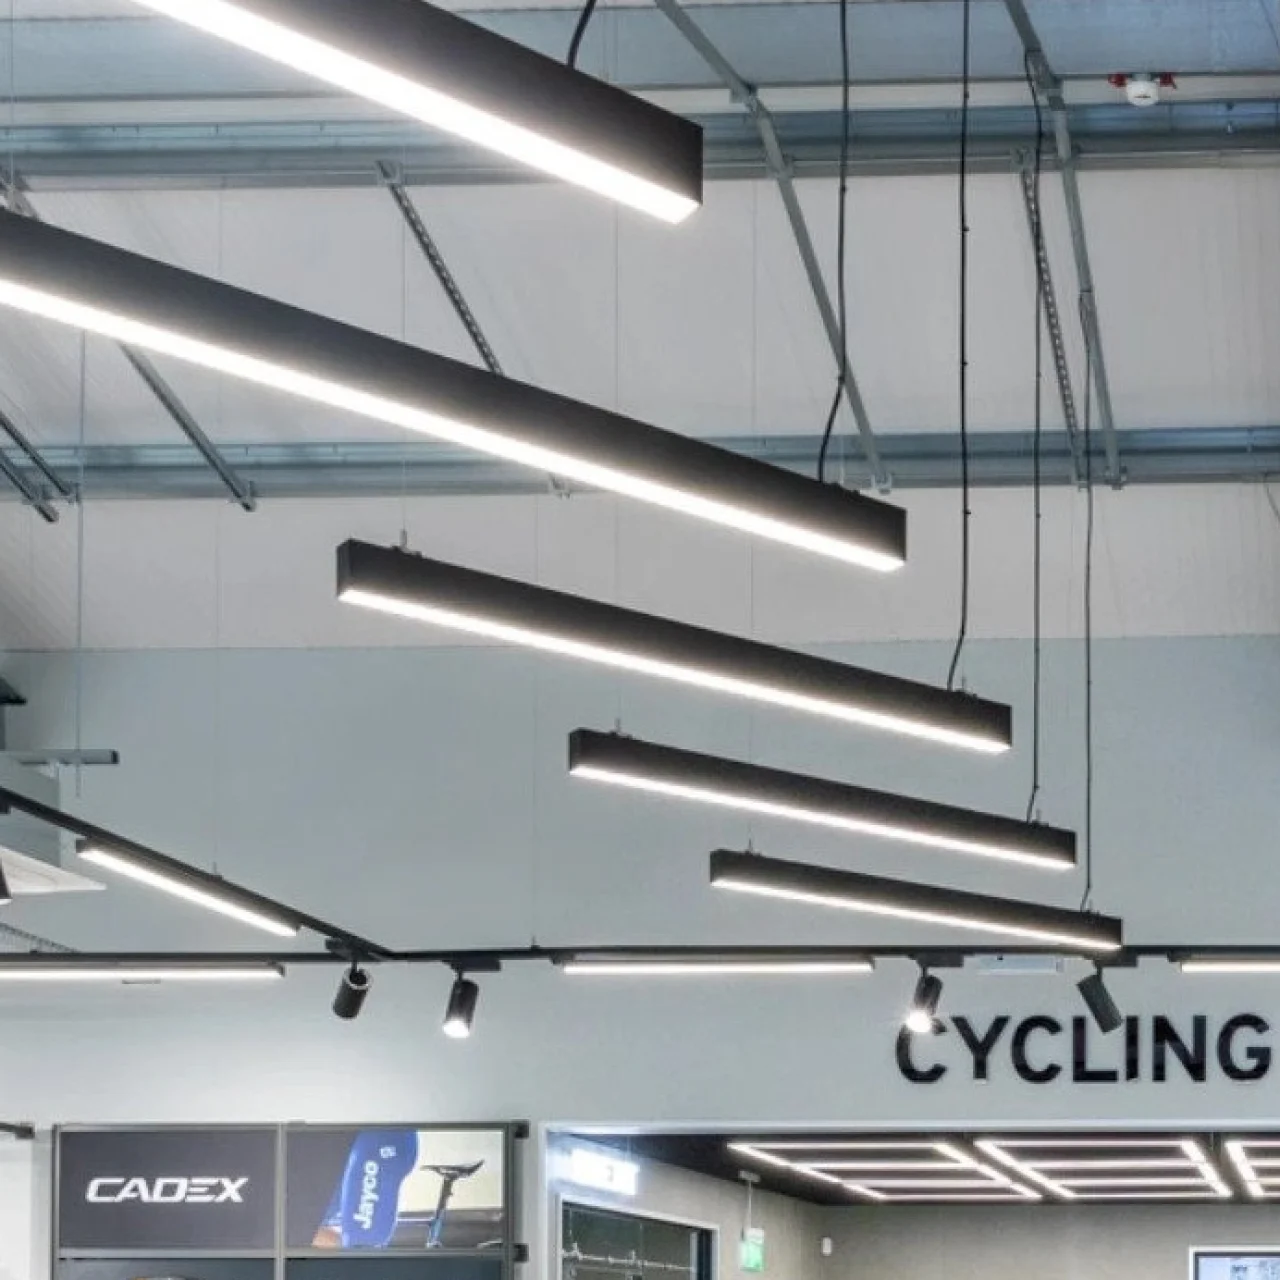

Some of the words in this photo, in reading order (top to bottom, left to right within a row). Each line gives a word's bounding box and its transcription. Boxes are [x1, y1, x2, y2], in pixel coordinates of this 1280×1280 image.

[896, 1013, 1273, 1084] CYCLING
[85, 1177, 249, 1203] CADEX
[353, 1160, 379, 1230] Jayco
